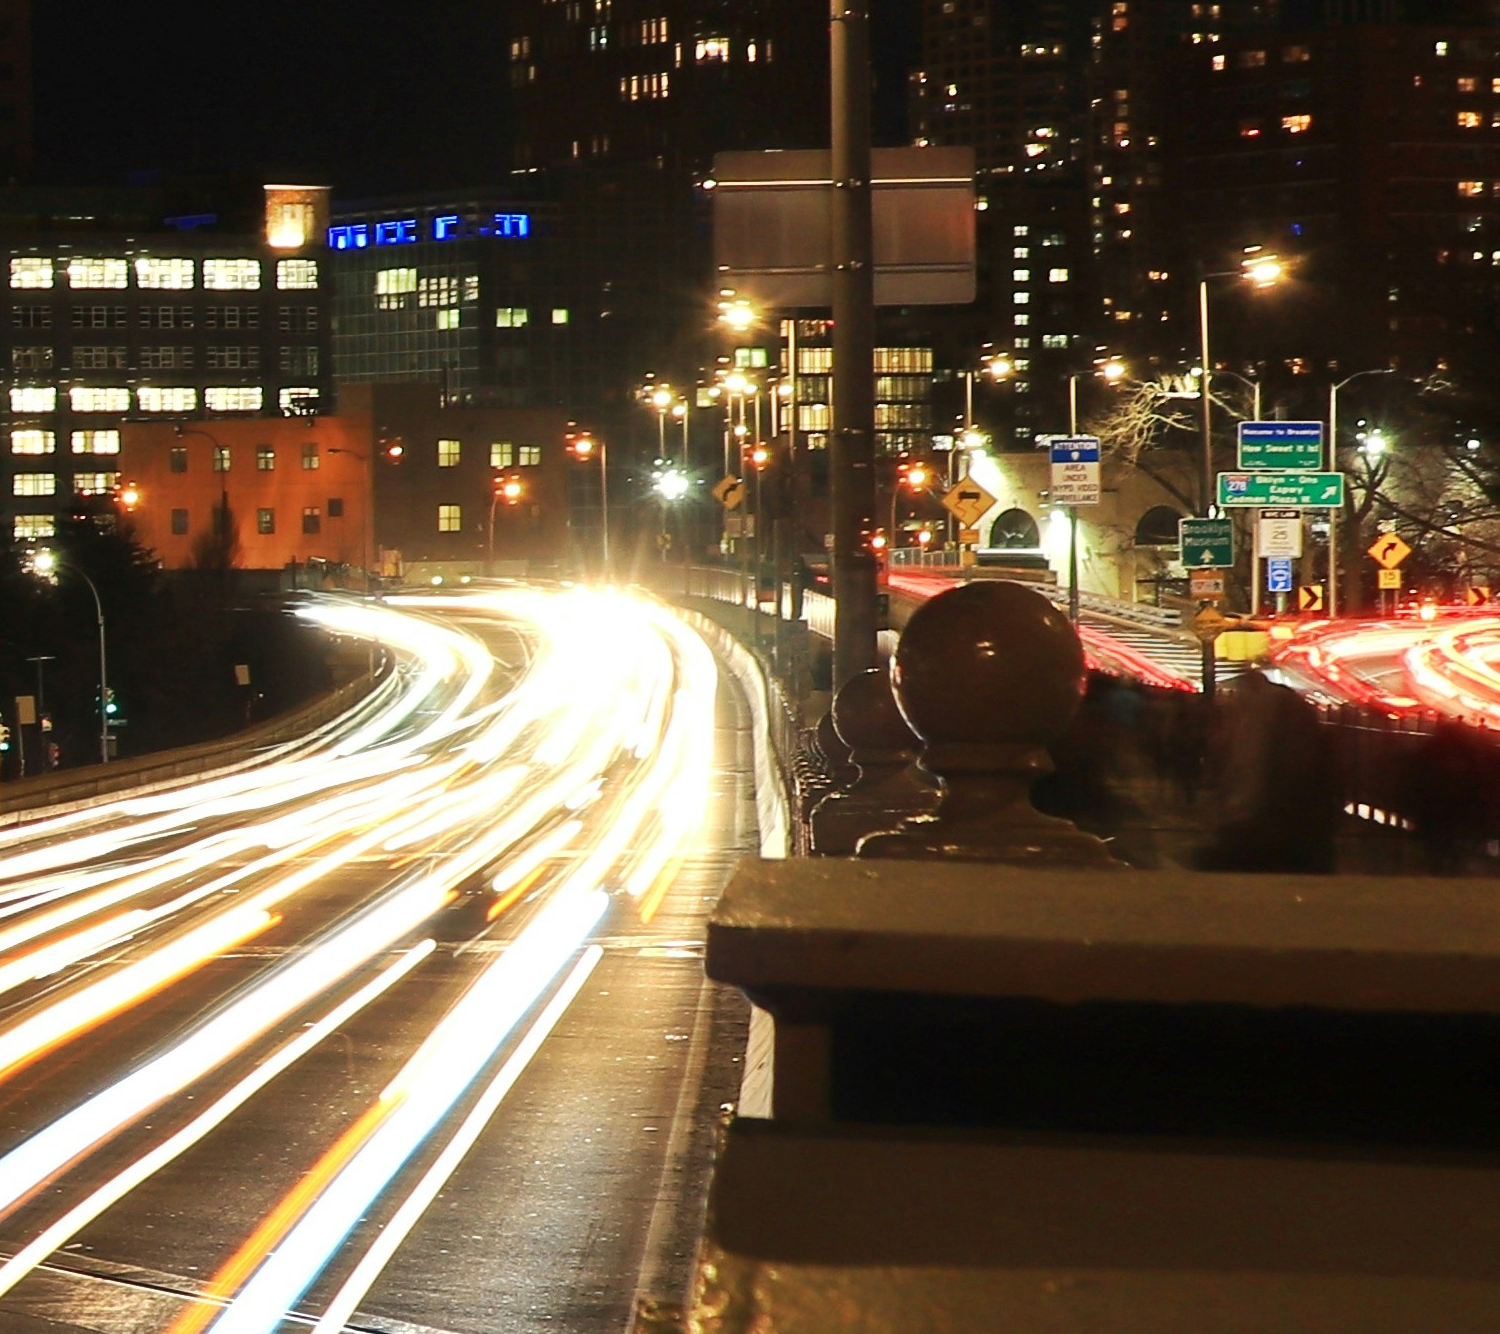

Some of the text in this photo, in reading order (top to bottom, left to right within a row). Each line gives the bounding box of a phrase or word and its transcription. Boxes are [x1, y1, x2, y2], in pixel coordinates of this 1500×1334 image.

[1053, 442, 1097, 450] ATTENTION
[1266, 444, 1293, 452] Sweet
[1228, 482, 1247, 491] 278
[1182, 524, 1230, 535] Brooklyn
[1272, 531, 1287, 540] 25
[1185, 537, 1229, 546] Museum
[1384, 572, 1396, 580] 15
